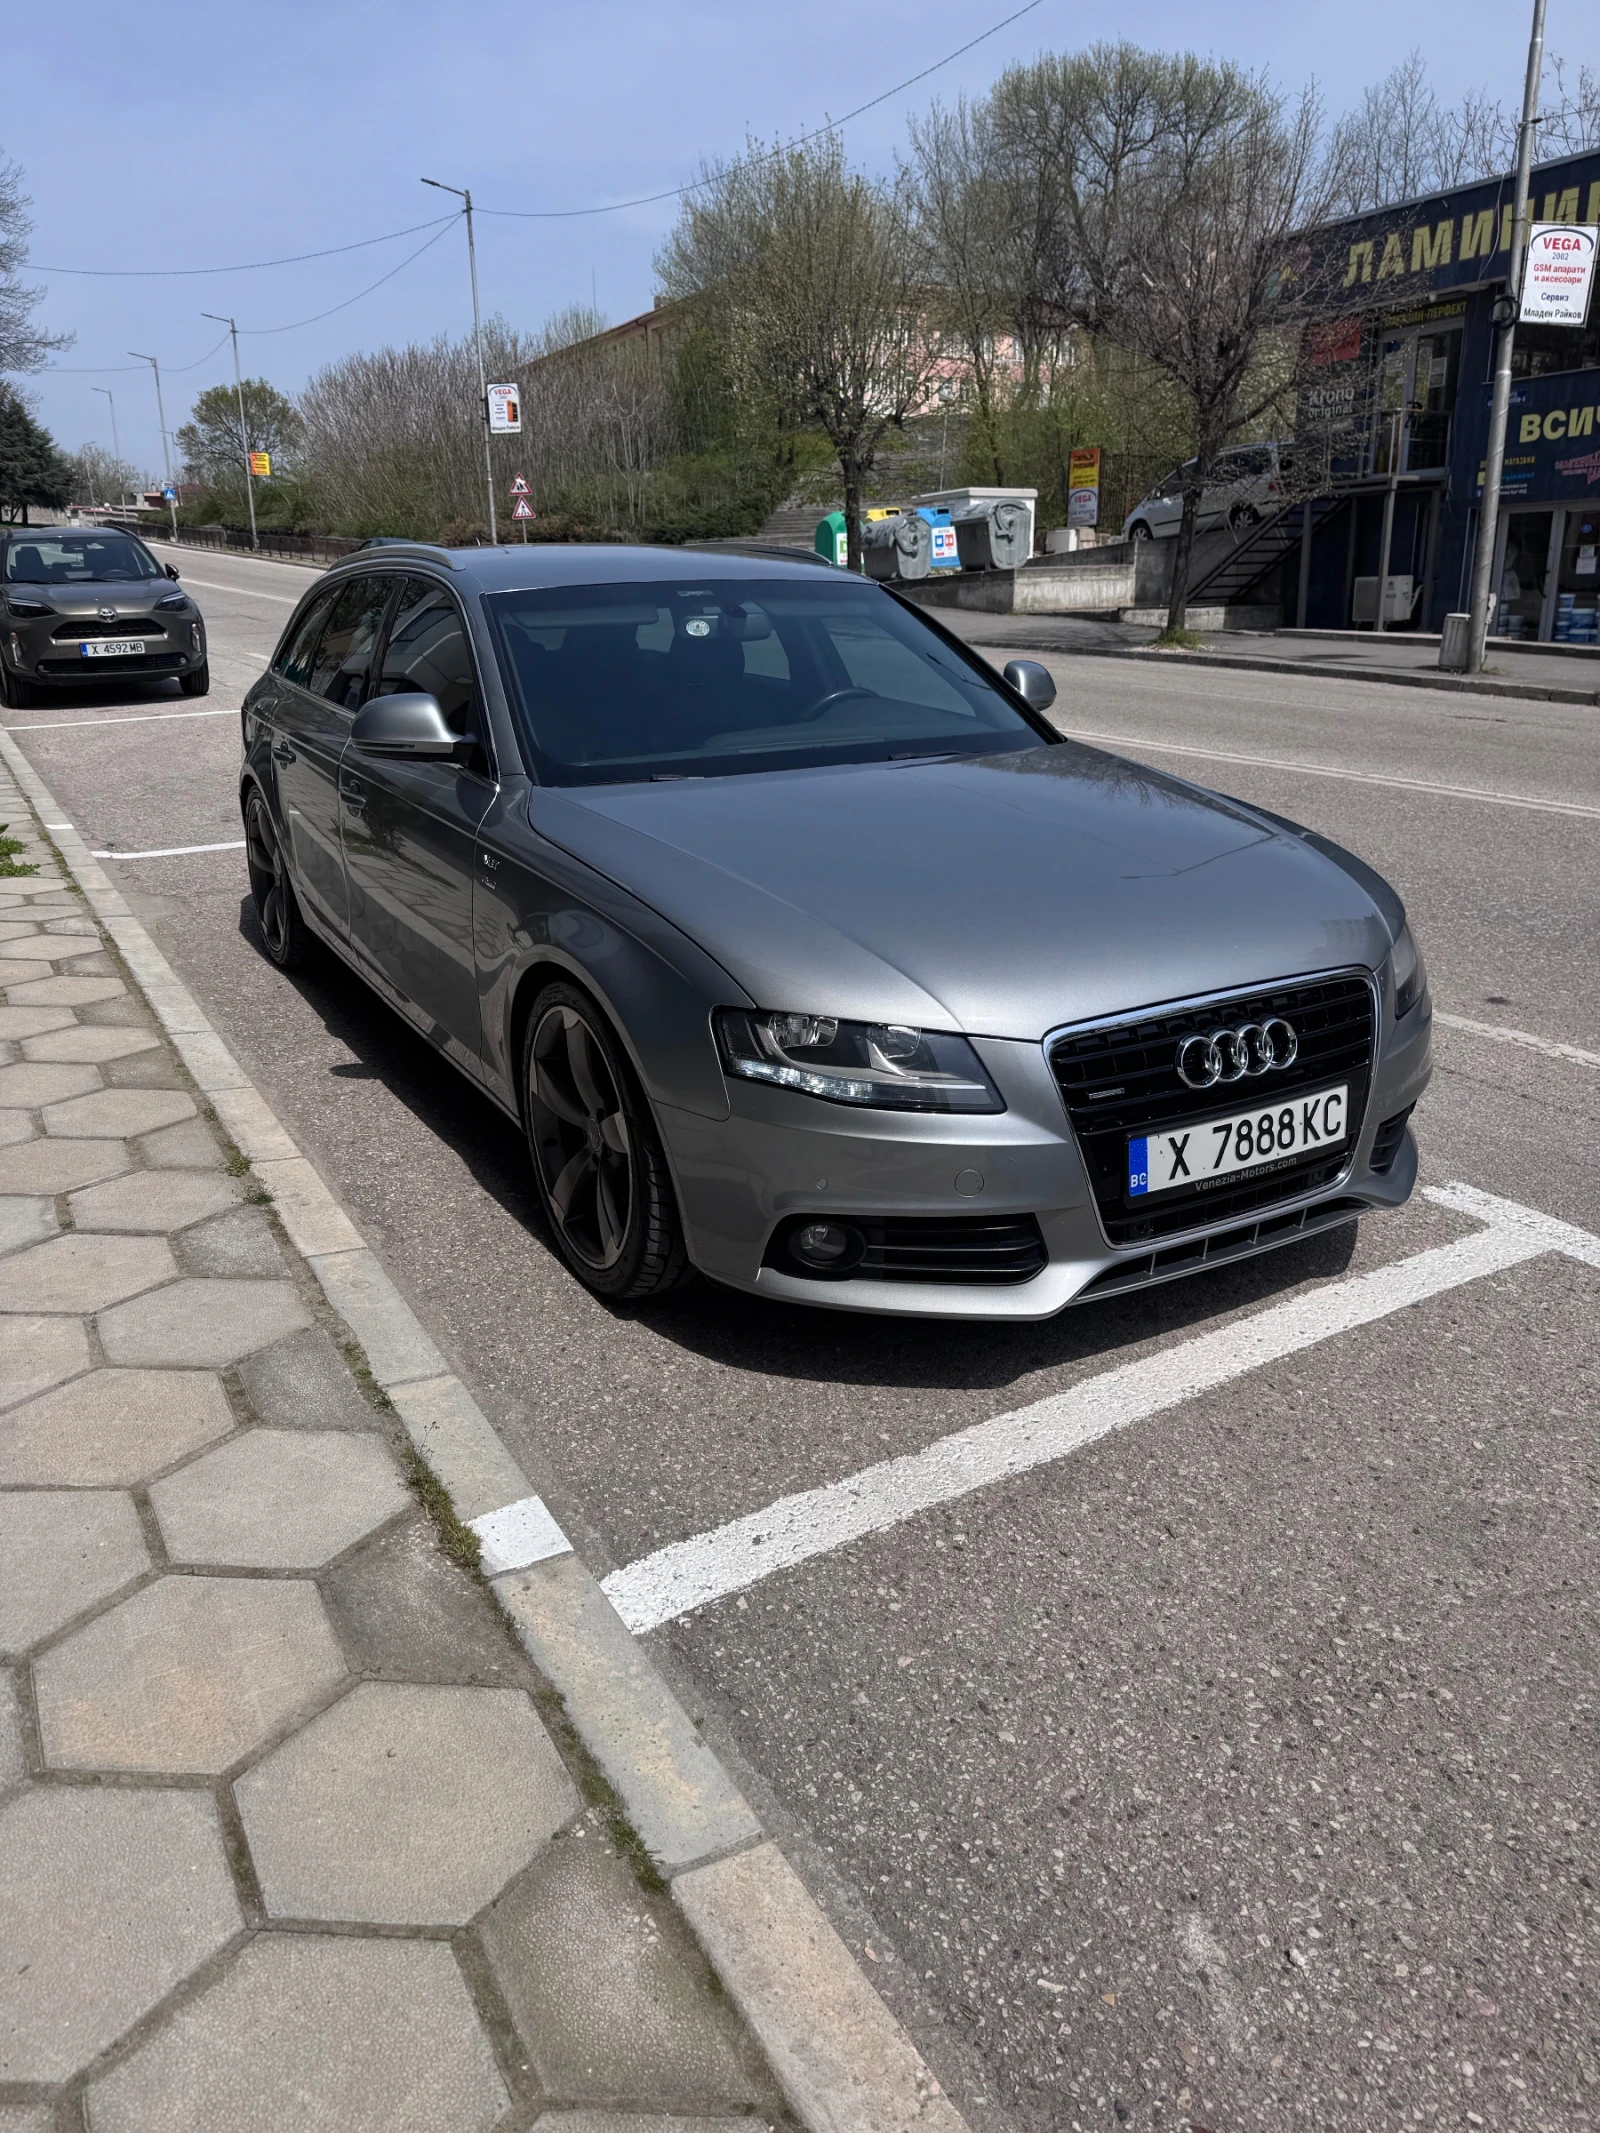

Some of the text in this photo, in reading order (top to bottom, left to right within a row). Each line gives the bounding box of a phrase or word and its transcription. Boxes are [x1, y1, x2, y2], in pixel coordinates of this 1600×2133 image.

[1343, 181, 1600, 287] ЛАМИИ
[1543, 237, 1581, 250] VEGA
[1552, 252, 1569, 260] 2002
[1533, 264, 1586, 274] GSM апарати
[1541, 275, 1582, 285] аксесоари
[1541, 292, 1569, 303] Сервиз
[1523, 308, 1582, 319] Младен Райков
[1519, 405, 1600, 443] ВСИ
[91, 645, 99, 655] X
[1168, 1133, 1191, 1180] X
[1194, 1156, 1297, 1192] Venezia-Motors.com
